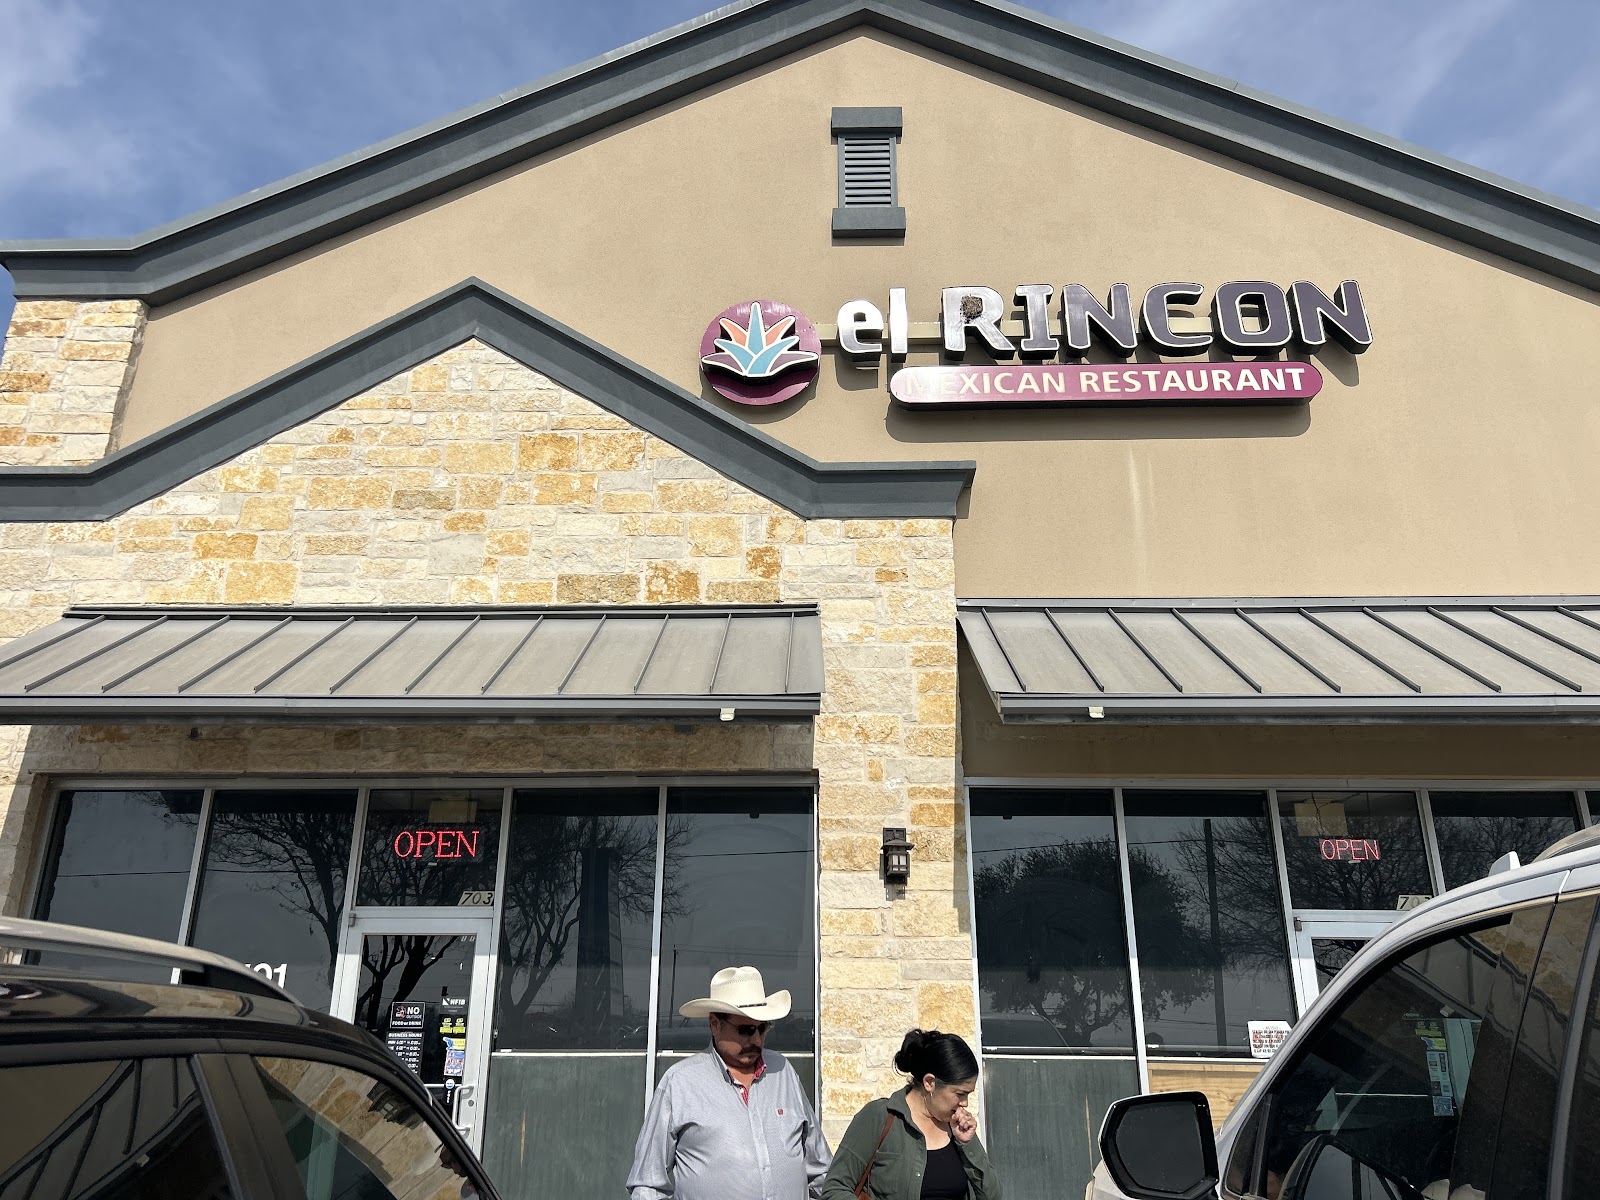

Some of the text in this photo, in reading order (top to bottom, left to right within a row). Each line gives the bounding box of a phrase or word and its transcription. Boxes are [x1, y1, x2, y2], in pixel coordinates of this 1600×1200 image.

[837, 281, 1373, 357] el RINCON
[904, 368, 1305, 395] MEXICAN RESTAURANT
[394, 831, 480, 858] OPEN
[1321, 839, 1380, 860] OPEN
[461, 892, 493, 905] 703
[1400, 896, 1431, 909] 70
[245, 963, 288, 989] 01
[407, 1006, 420, 1015] NO
